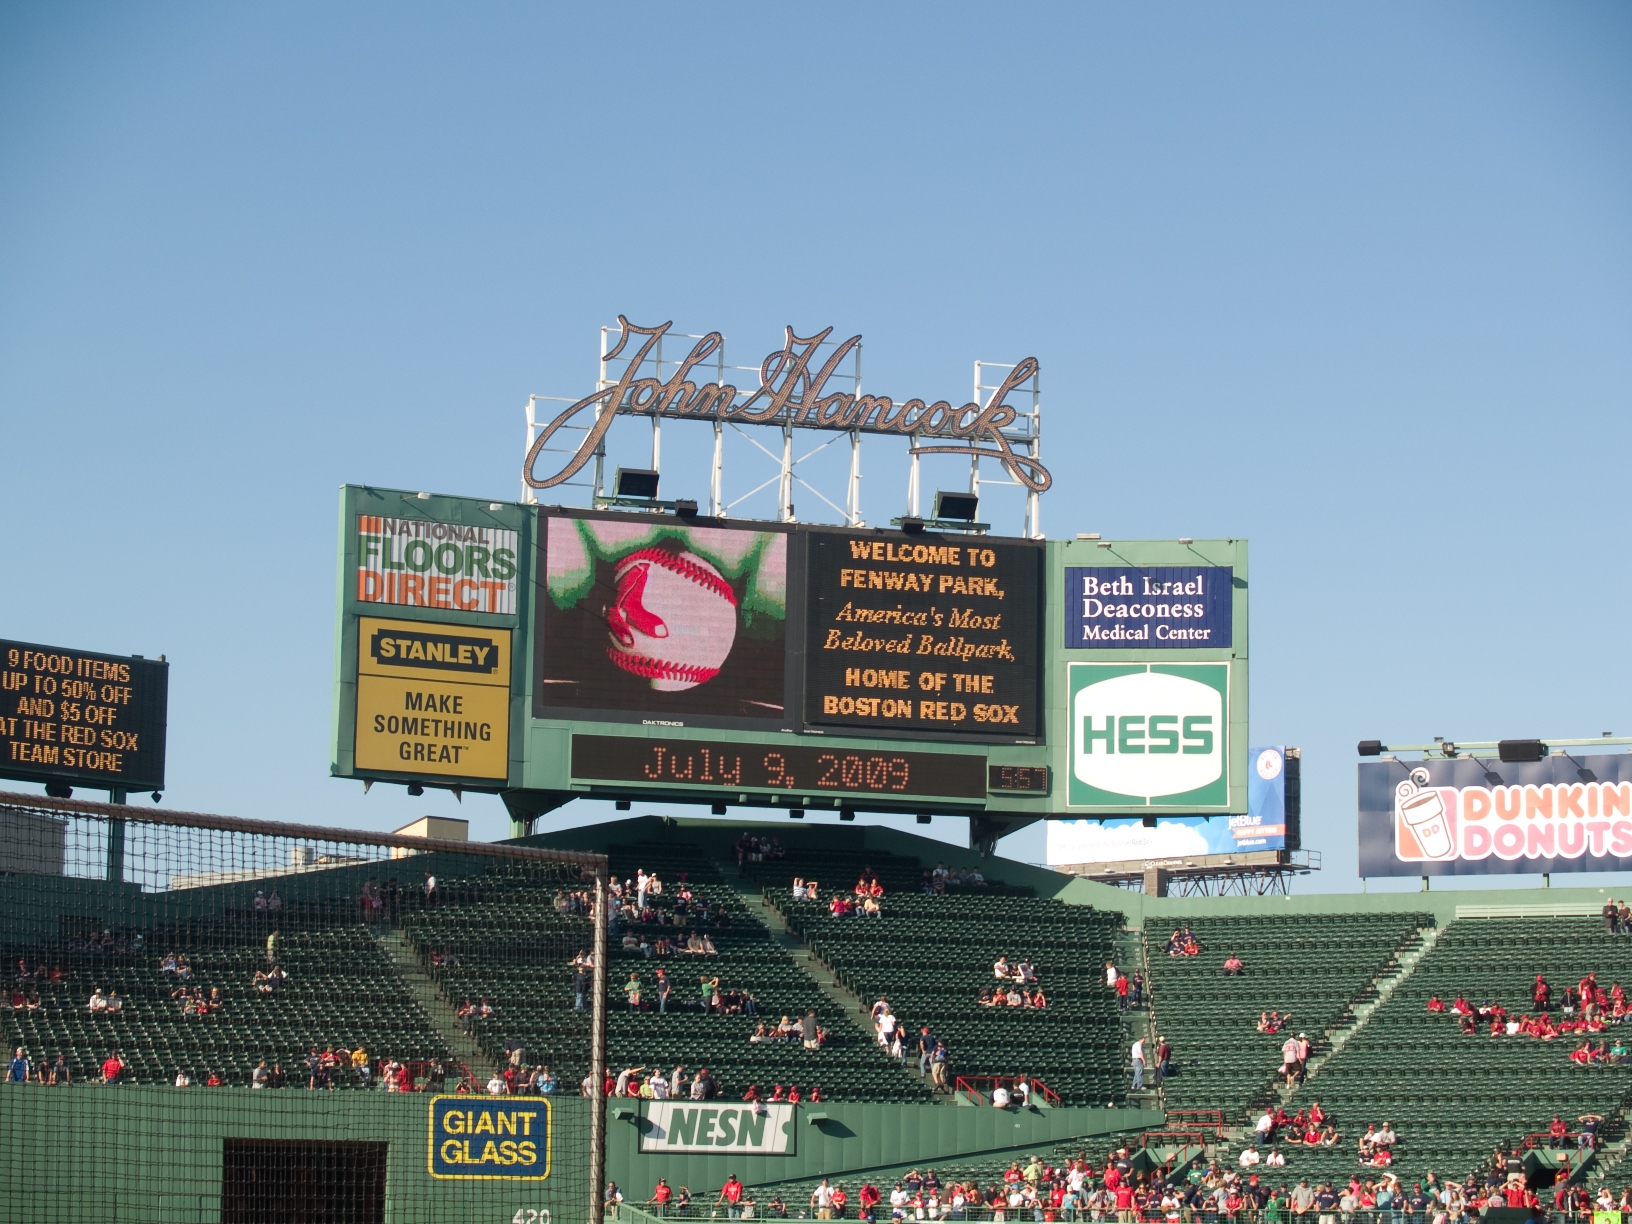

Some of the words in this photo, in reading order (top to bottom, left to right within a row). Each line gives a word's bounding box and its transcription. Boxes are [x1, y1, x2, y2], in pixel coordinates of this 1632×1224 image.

[523, 314, 739, 489] John
[727, 325, 1053, 492] Hancock
[383, 519, 490, 545] NATIONAL
[358, 534, 517, 580] FLOORS
[850, 540, 961, 566] WELCOME
[967, 548, 996, 568] TO
[357, 569, 506, 614] DIRECT
[840, 568, 935, 592] FENWAY
[939, 574, 1005, 600] PARK,
[1082, 575, 1134, 596] Beth
[1142, 574, 1204, 596] Israel
[835, 601, 944, 627] America's
[948, 607, 1001, 630] Most
[1082, 598, 1204, 619] Deaconess
[823, 629, 913, 654] Beloved
[916, 634, 1016, 662] Ballpark,
[1082, 624, 1149, 641] Medical
[1155, 624, 1211, 641] Center
[8, 648, 20, 668] 9
[23, 650, 74, 675] FOOD
[77, 658, 131, 683] ITEMS
[379, 636, 491, 667] STANLEY
[2, 670, 28, 691] UP
[34, 674, 57, 696] TO
[61, 679, 97, 701] 50%
[101, 684, 133, 705] OFF
[845, 667, 911, 690] HOME
[918, 671, 947, 692] OF
[952, 672, 994, 694] THE
[17, 696, 55, 718] AND
[60, 699, 81, 722] $5
[85, 705, 117, 726] OFF
[405, 690, 464, 715] MAKE
[823, 695, 912, 719] BOSTON
[919, 700, 967, 722] RED
[973, 703, 1020, 724] SOX
[23, 719, 57, 742] THE
[61, 724, 97, 746] RED
[100, 729, 139, 752] SOX
[373, 713, 491, 742] SOMETHING
[642, 719, 684, 727] DAKTRONICS
[1083, 715, 1214, 755] HESS
[9, 741, 59, 765] TEAM
[63, 747, 123, 772] STORE
[399, 741, 463, 765] GREAT
[644, 746, 742, 788] July
[763, 753, 795, 789] 9,
[817, 754, 910, 791] 2009
[1001, 767, 1046, 790] 5:57
[1463, 785, 1631, 821] DUNKIN
[1227, 815, 1262, 830] jetBlue
[1422, 824, 1440, 838] DD
[1463, 820, 1632, 857] DONUTS
[442, 1109, 537, 1136] GIANT
[667, 1108, 768, 1147] NESN
[440, 1138, 538, 1166] GLASS
